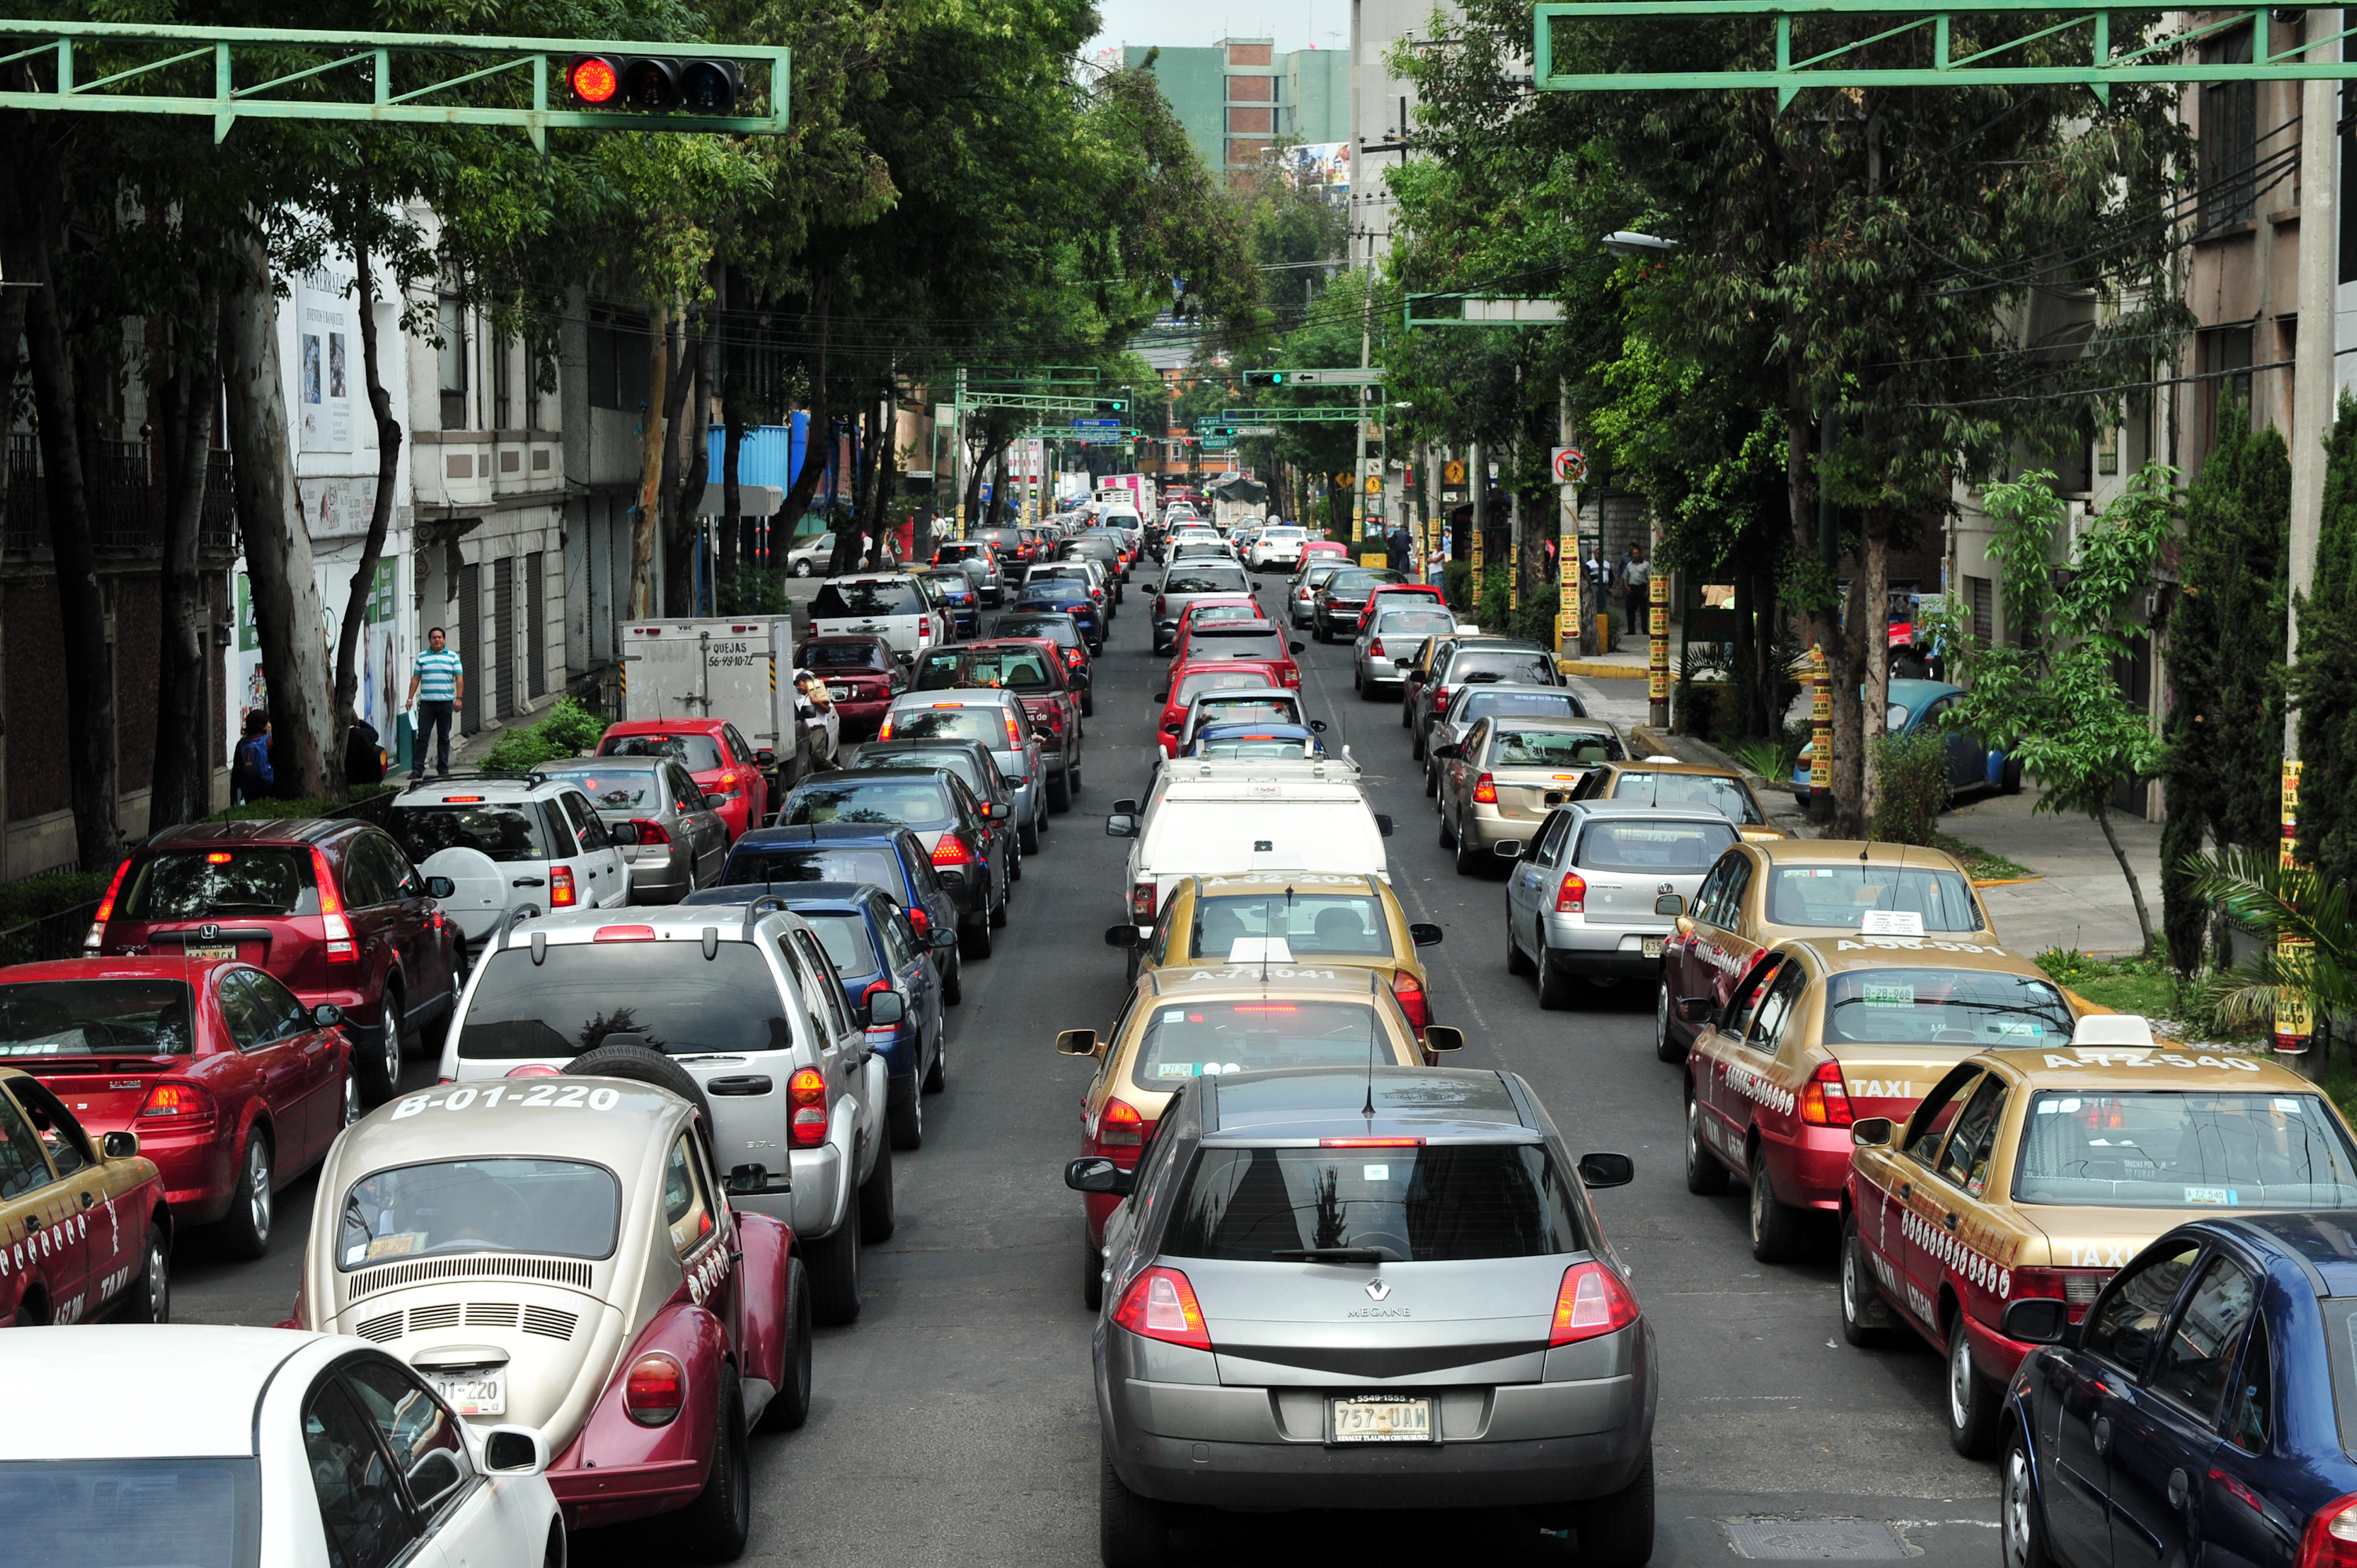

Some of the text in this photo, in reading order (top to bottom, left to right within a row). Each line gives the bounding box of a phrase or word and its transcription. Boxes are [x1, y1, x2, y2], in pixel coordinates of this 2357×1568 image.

[714, 642, 746, 654] QUEJAS
[1209, 875, 1363, 886] A-32-204
[1837, 939, 2007, 956] A-56-591
[1189, 969, 1335, 980] A-71-041
[1865, 988, 1911, 1000] B-28-968
[2043, 1054, 2261, 1071] A-72-540
[1850, 1080, 1911, 1098] TAXI
[390, 1085, 619, 1121] B-01-220
[2124, 1159, 2141, 1168] GRACIAS
[2188, 1190, 2224, 1199] A-72-540
[372, 1240, 409, 1252] B-01-220
[2066, 1245, 2134, 1266] TAXI
[101, 1265, 129, 1303] TAXI
[1347, 1307, 1411, 1317] MEGANE
